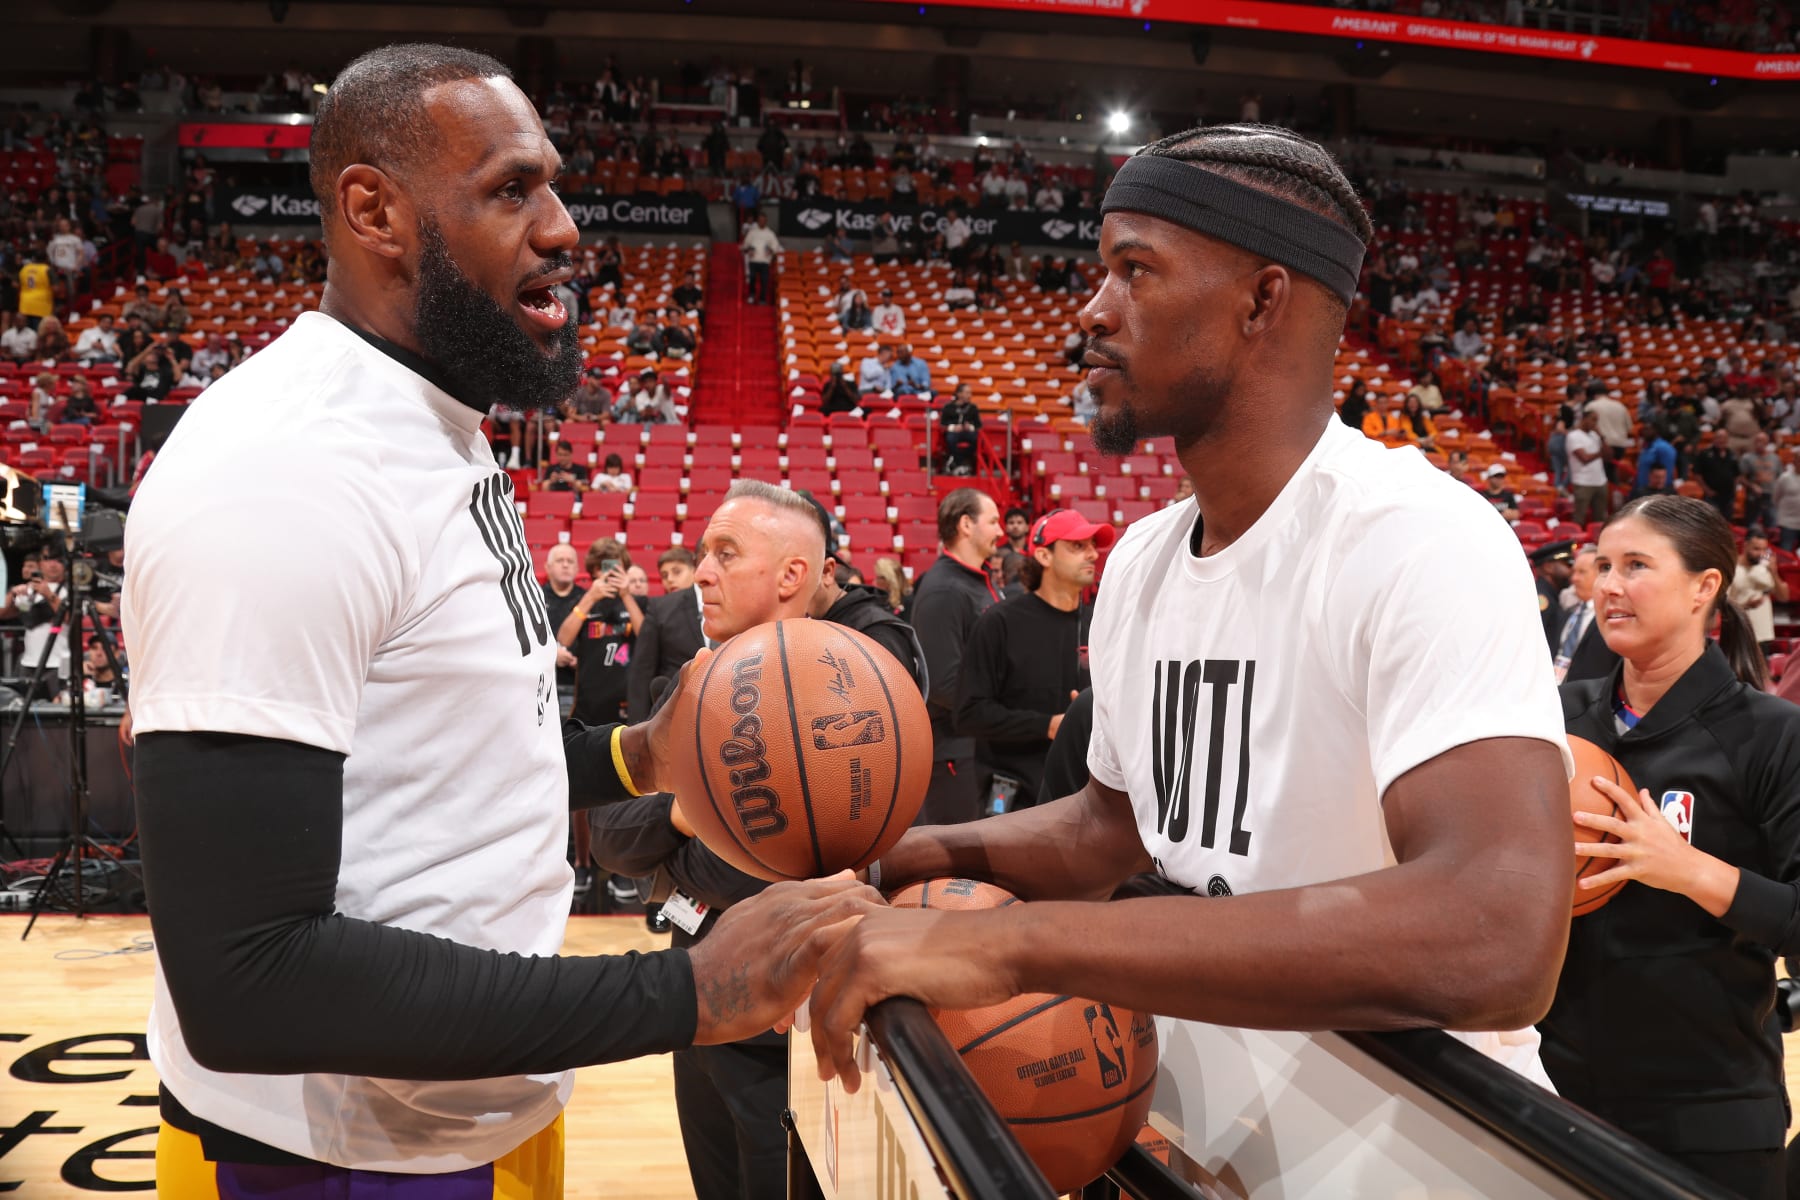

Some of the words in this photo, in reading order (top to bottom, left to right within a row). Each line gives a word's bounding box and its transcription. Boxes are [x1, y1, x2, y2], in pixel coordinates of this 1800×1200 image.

[1332, 16, 1398, 35] AMERANT
[1407, 23, 1452, 39] OFFICIAL
[1454, 28, 1482, 42] BANK
[1483, 31, 1498, 43] OF
[1499, 33, 1518, 45] THE
[1519, 36, 1549, 48] MIAMI
[1552, 40, 1577, 52] HEAT
[612, 200, 693, 224] Center
[835, 208, 913, 233] Kasya
[920, 211, 998, 234] Ceter
[603, 642, 630, 667] 14
[720, 651, 789, 845] Wilson
[849, 757, 861, 774] BALL
[849, 774, 862, 793] GAME
[1016, 1059, 1048, 1080] OFFICIAL
[1049, 1053, 1069, 1070] GAME
[1069, 1048, 1086, 1065] BALL
[1104, 1069, 1118, 1085] NBA
